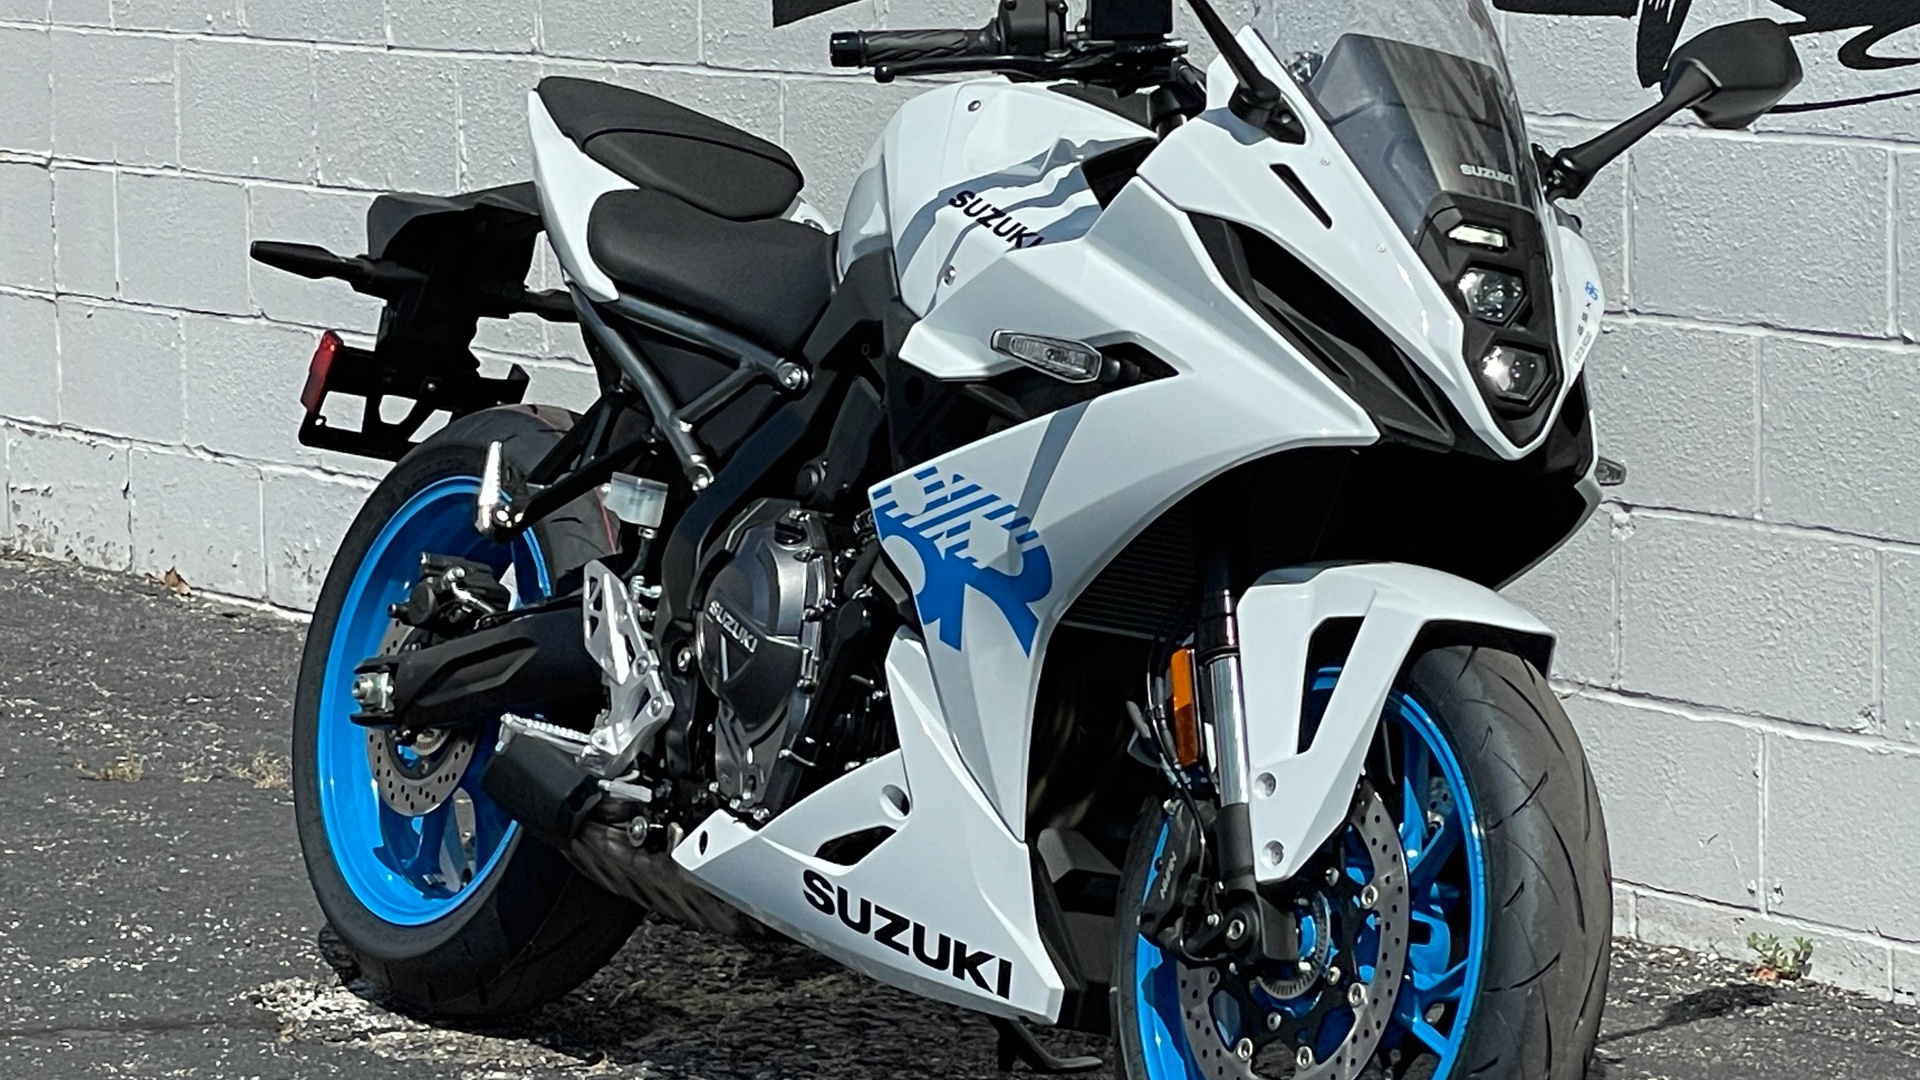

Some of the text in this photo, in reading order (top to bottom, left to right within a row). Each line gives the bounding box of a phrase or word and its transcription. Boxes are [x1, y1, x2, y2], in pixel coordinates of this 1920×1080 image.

[1460, 164, 1516, 187] SUZUKI
[709, 600, 758, 654] SUZUKI
[803, 869, 1013, 1001] SUZUKI
